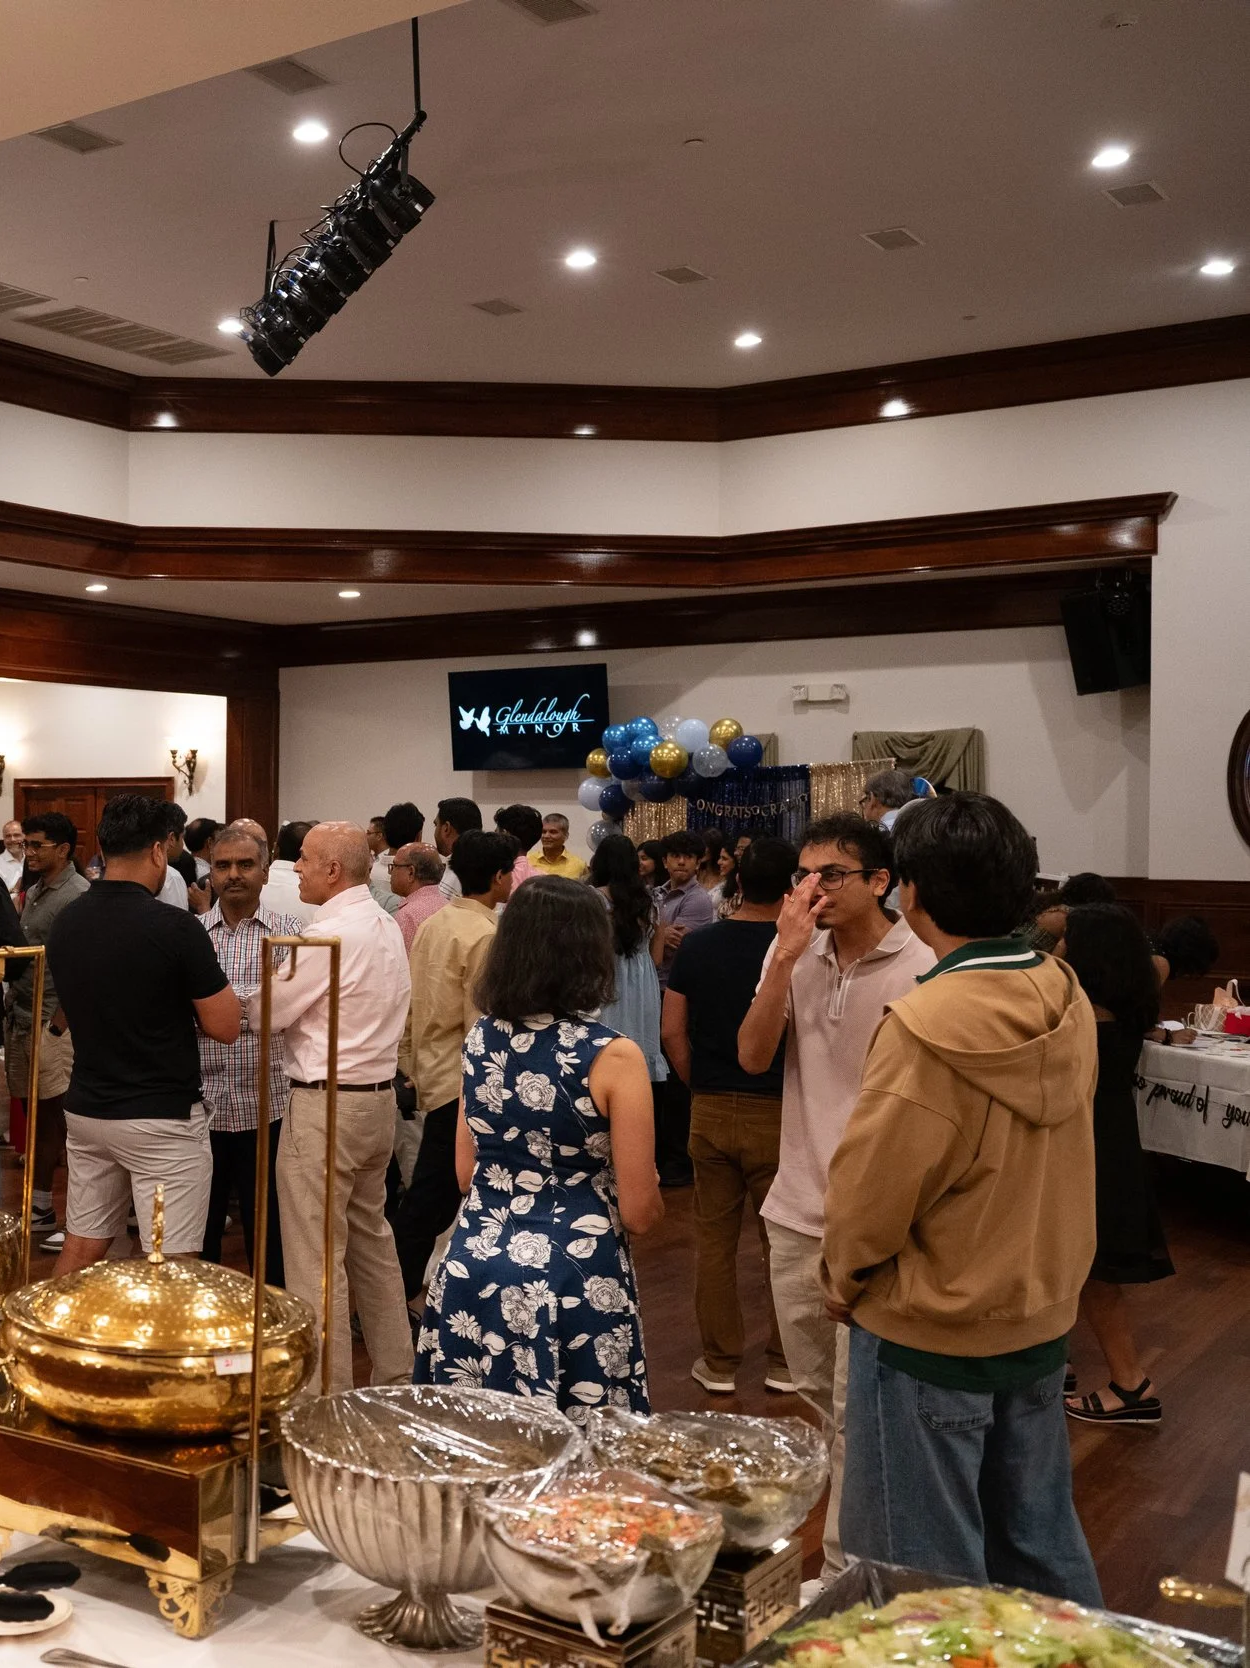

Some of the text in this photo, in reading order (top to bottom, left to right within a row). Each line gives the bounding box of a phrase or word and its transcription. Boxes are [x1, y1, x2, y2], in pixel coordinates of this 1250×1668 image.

[495, 693, 591, 738] Glendalough
[497, 723, 581, 735] MANOR
[688, 798, 751, 819] ONGRATS
[1145, 1083, 1196, 1109] proud
[1196, 1085, 1210, 1124] of
[1222, 1103, 1250, 1129] you
